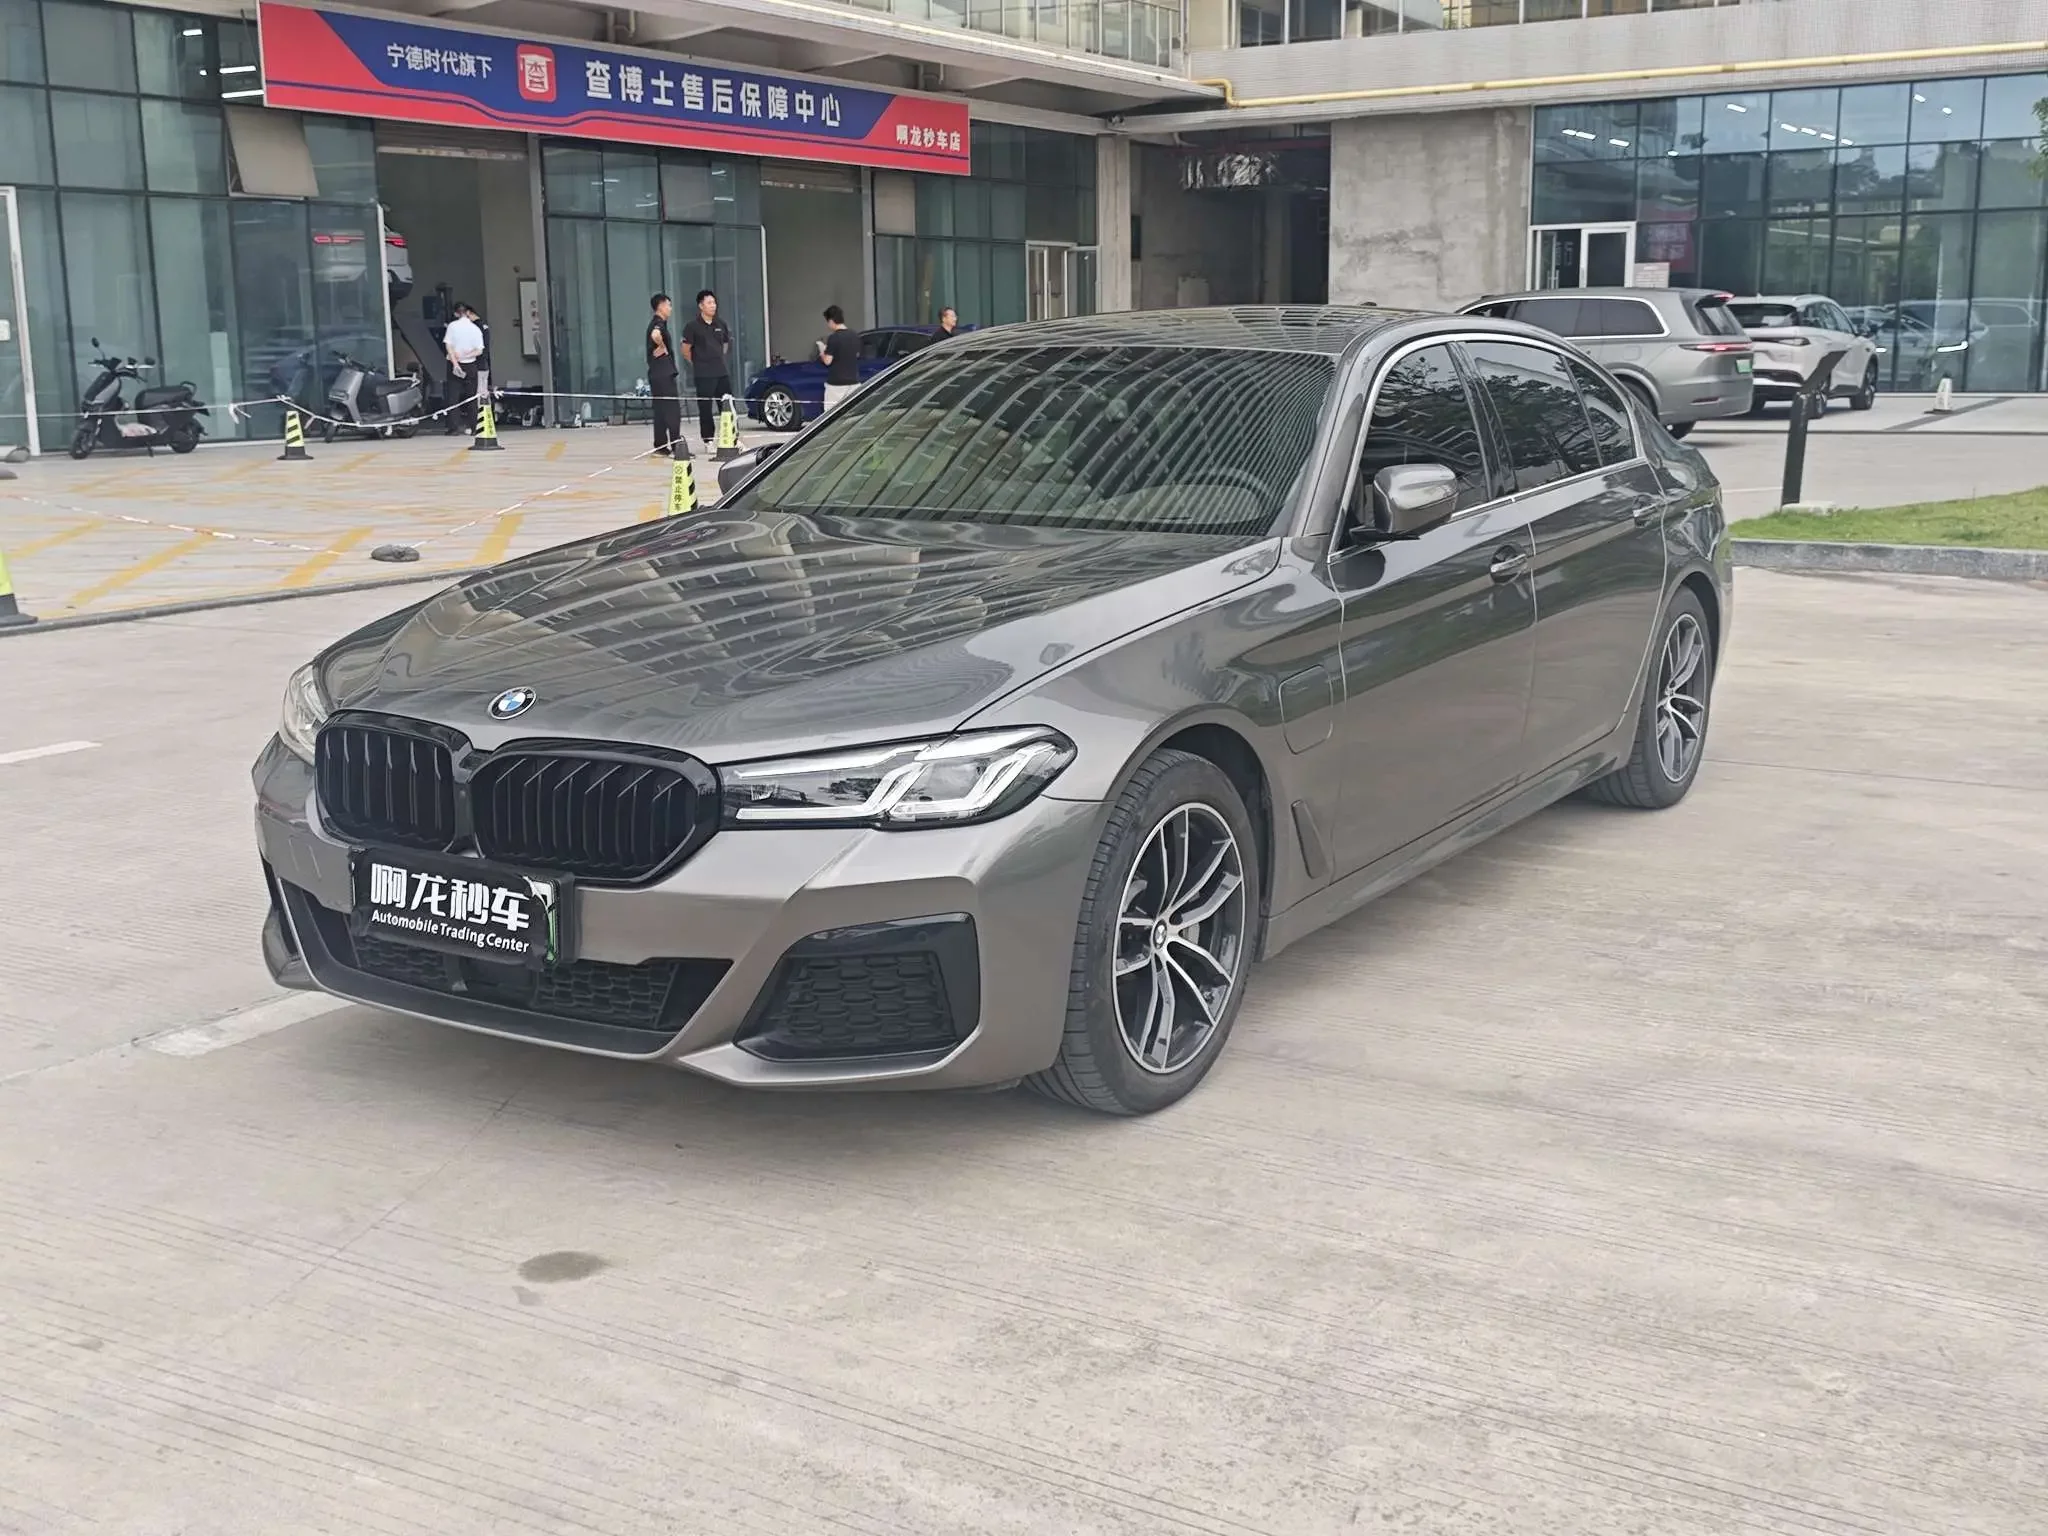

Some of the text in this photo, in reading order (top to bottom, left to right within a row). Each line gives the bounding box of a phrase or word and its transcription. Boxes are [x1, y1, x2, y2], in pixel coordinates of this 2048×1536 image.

[387, 43, 493, 79] 宁德时代旗下
[585, 60, 842, 128] 查博士售后保障中心
[370, 863, 530, 931] 啊龙秒车
[371, 909, 530, 953] Automobile Trading Center
